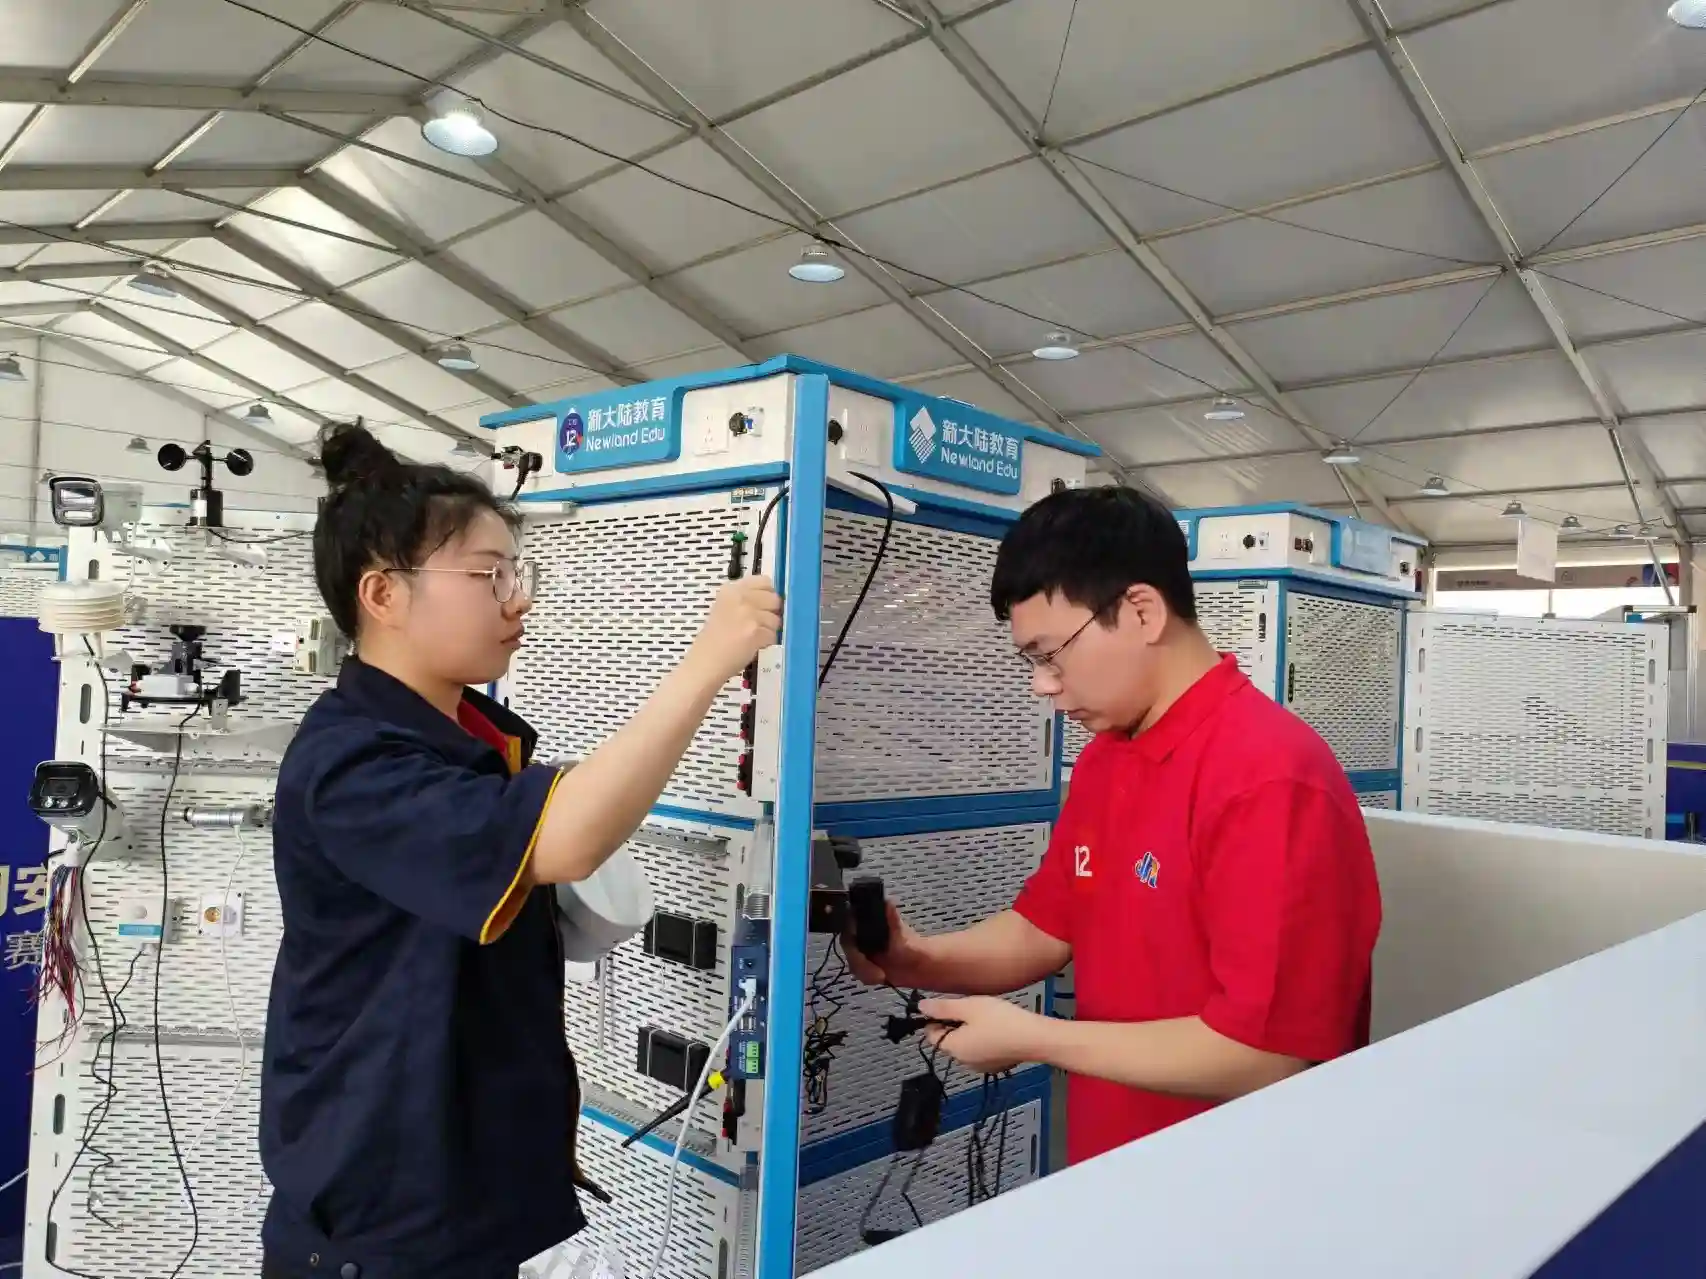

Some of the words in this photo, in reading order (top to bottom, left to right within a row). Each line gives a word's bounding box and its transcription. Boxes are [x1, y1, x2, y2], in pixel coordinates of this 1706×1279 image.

[587, 396, 667, 433] 新大陆教育
[565, 430, 577, 447] 12
[586, 430, 638, 452] Newland
[641, 427, 665, 444] Edu
[941, 419, 1020, 460] 新大陆教育
[940, 447, 994, 473] Newland
[996, 461, 1018, 479] Edu
[1074, 845, 1093, 877] 12
